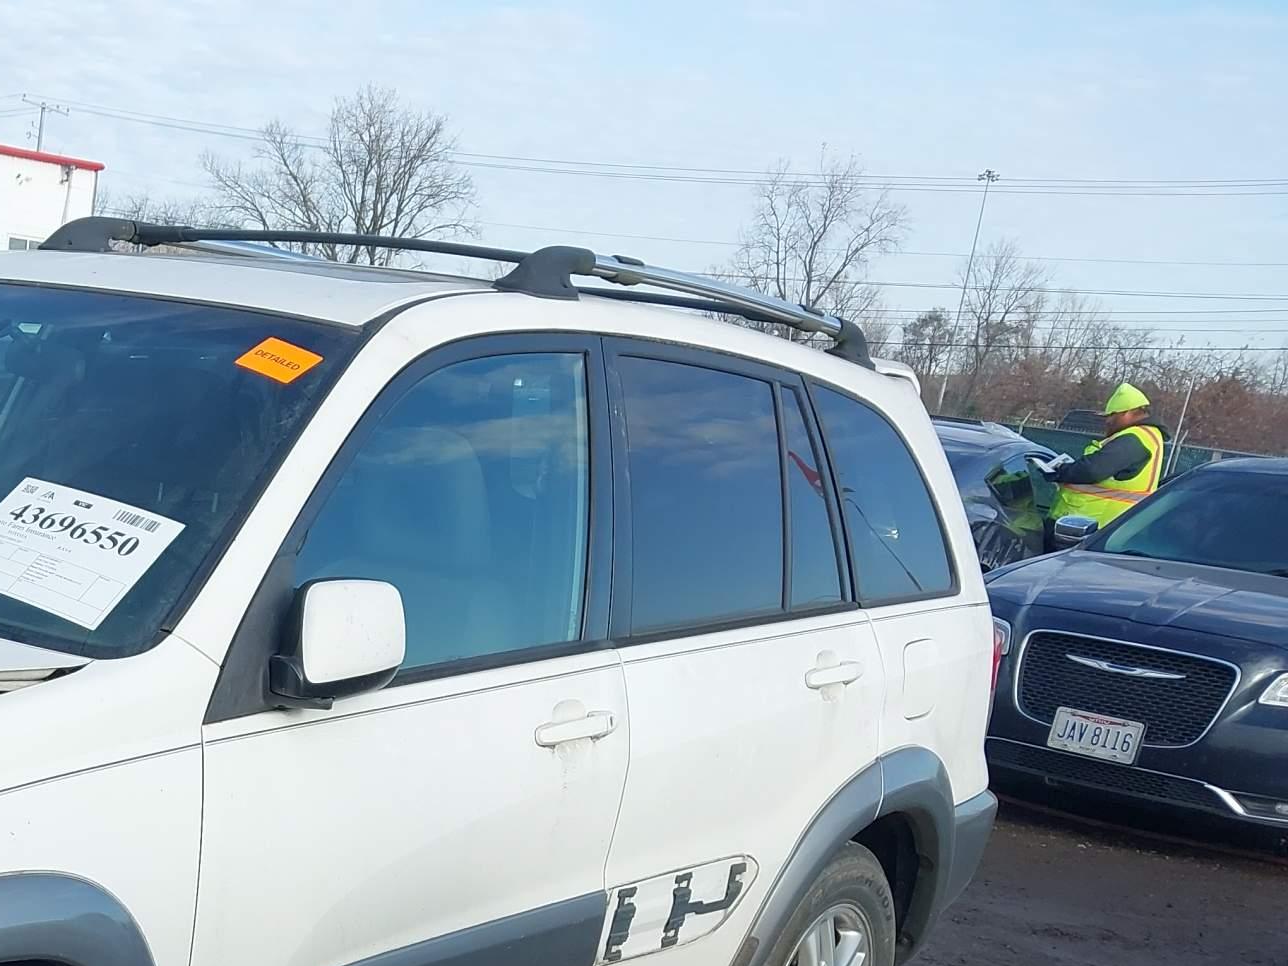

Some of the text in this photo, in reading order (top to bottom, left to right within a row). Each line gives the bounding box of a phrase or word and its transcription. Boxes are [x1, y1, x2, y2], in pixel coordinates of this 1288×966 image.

[254, 349, 300, 370] DETAILED
[9, 503, 140, 557] 43696550
[1057, 719, 1133, 753] JAV 8116
